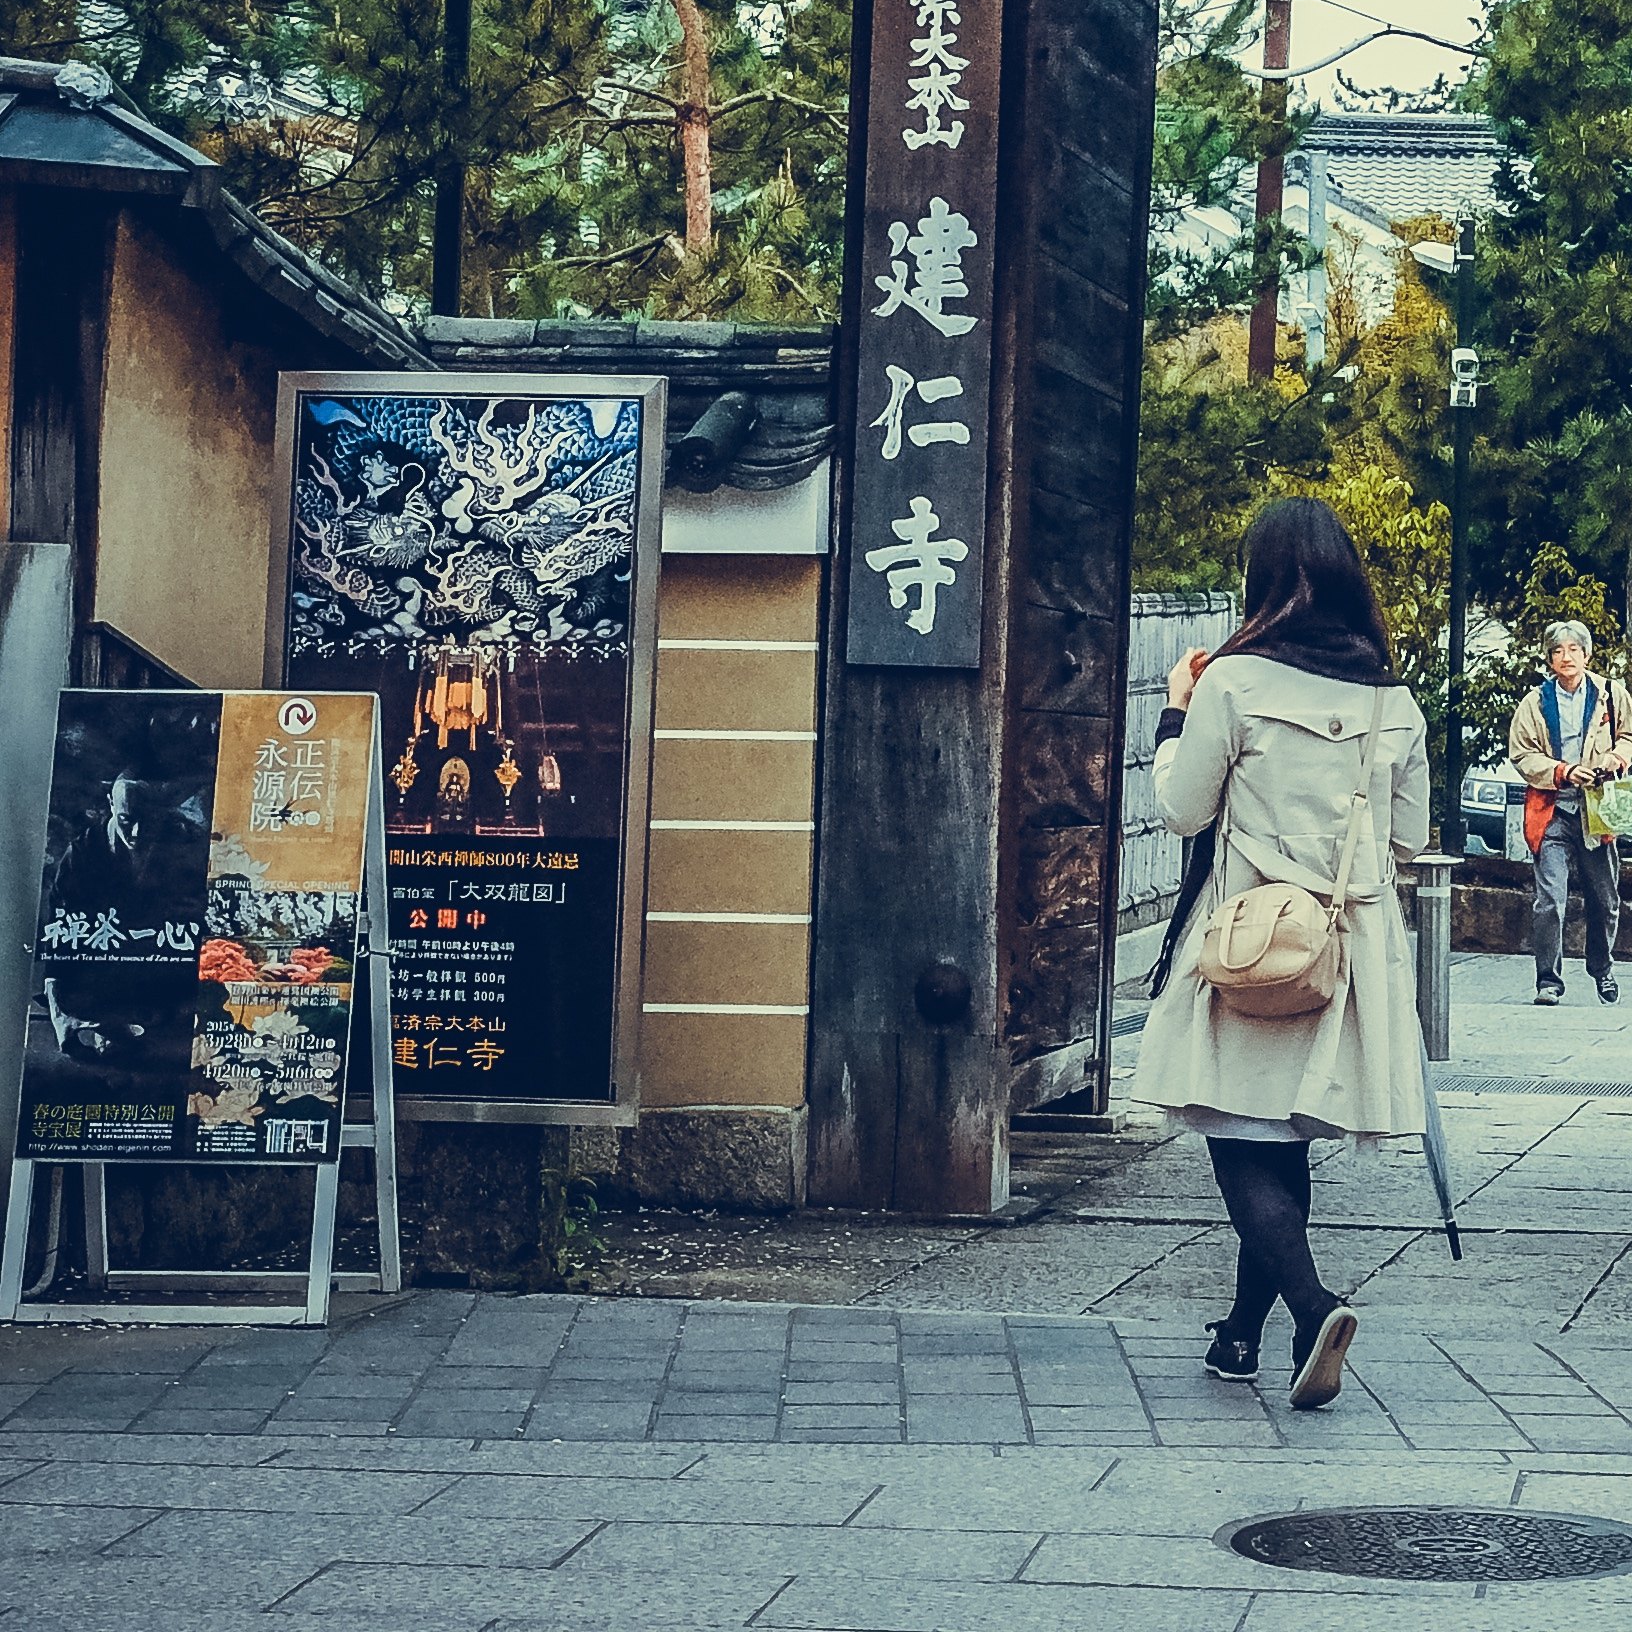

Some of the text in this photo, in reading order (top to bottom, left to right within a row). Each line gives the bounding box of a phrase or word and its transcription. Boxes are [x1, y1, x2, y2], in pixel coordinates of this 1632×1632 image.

[865, 196, 979, 635] 建仁寺
[303, 880, 350, 889] OPENING
[409, 908, 486, 930] 公開中
